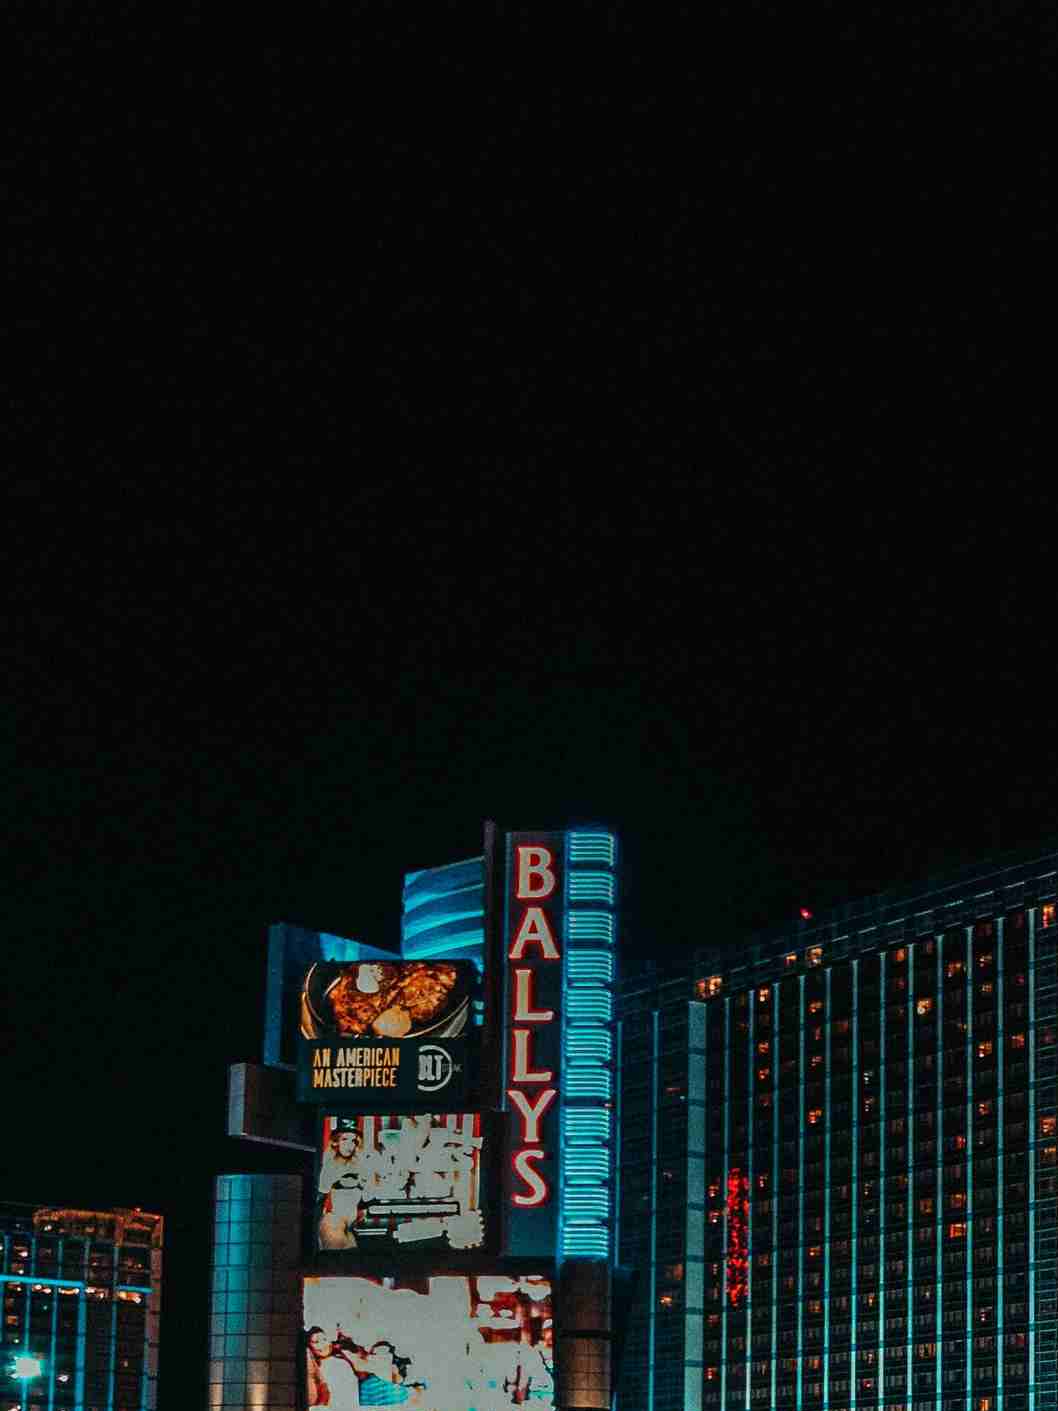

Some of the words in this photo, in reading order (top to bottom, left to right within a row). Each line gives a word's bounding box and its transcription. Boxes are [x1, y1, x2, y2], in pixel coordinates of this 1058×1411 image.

[508, 846, 560, 1205] BALLYS
[312, 1048, 332, 1067] AN
[336, 1047, 400, 1067] AMERICAN
[313, 1067, 398, 1088] MASTERPIECE
